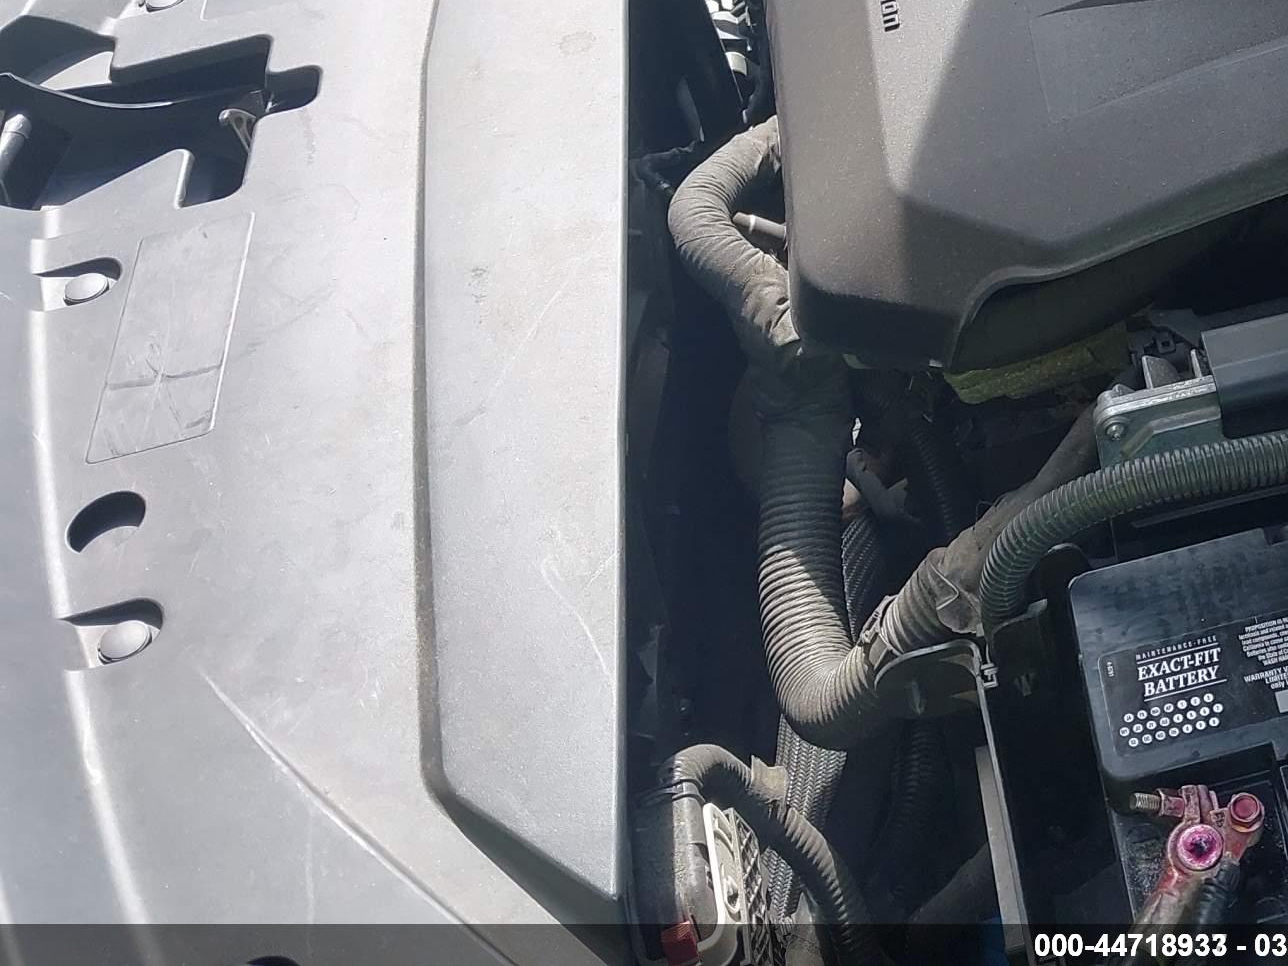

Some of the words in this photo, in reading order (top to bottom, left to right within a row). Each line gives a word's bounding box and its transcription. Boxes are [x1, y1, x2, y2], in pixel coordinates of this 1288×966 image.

[1135, 635, 1216, 660] MAINTENANCE-FREE
[1137, 647, 1221, 681] EXACT-FIT
[1244, 667, 1281, 682] WARRANTY
[1144, 665, 1219, 697] BATTERY
